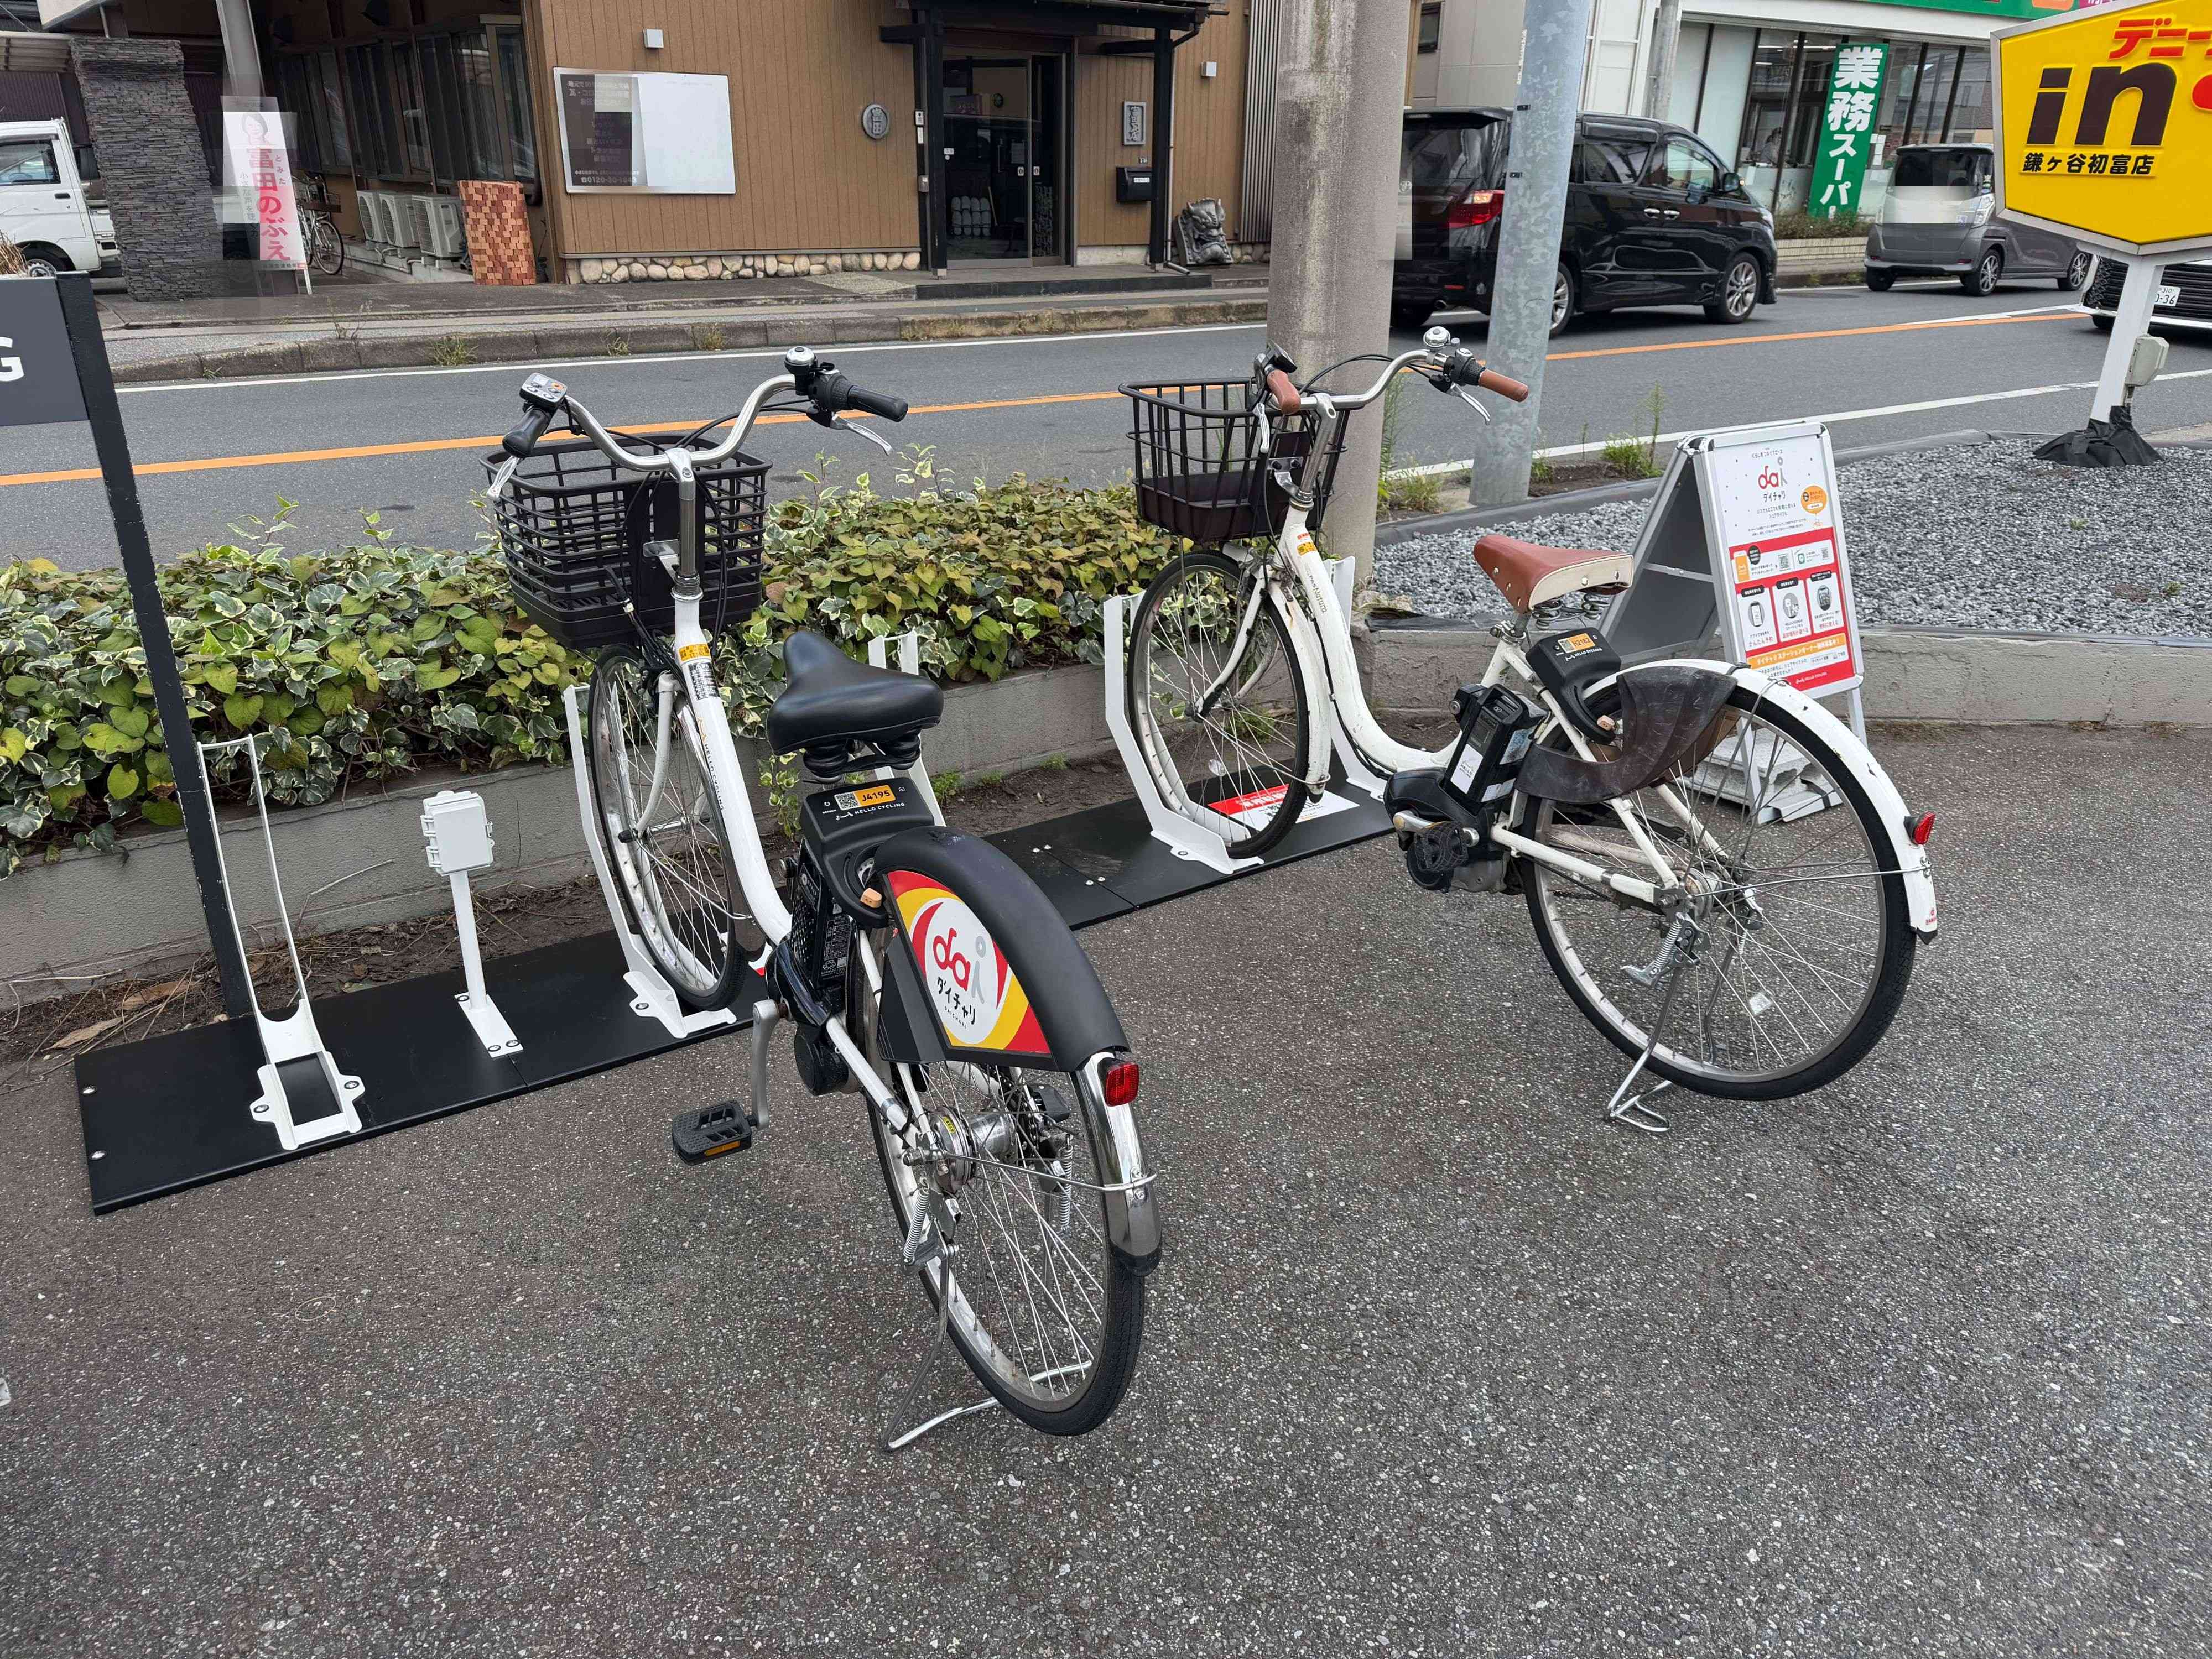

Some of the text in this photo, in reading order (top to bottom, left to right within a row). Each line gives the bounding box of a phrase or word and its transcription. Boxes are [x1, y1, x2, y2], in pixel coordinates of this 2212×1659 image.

[2109, 18, 2212, 59] デニー
[2026, 62, 2177, 145] in
[1763, 491, 1786, 502] ダイチャリ
[705, 744, 724, 810] HELLO CYCLING
[862, 790, 891, 801] J4195
[855, 806, 876, 815] HELLO
[933, 928, 987, 1004] dai
[938, 977, 976, 1025] ダイチャリ
[944, 1006, 967, 1029] DAICHARI
